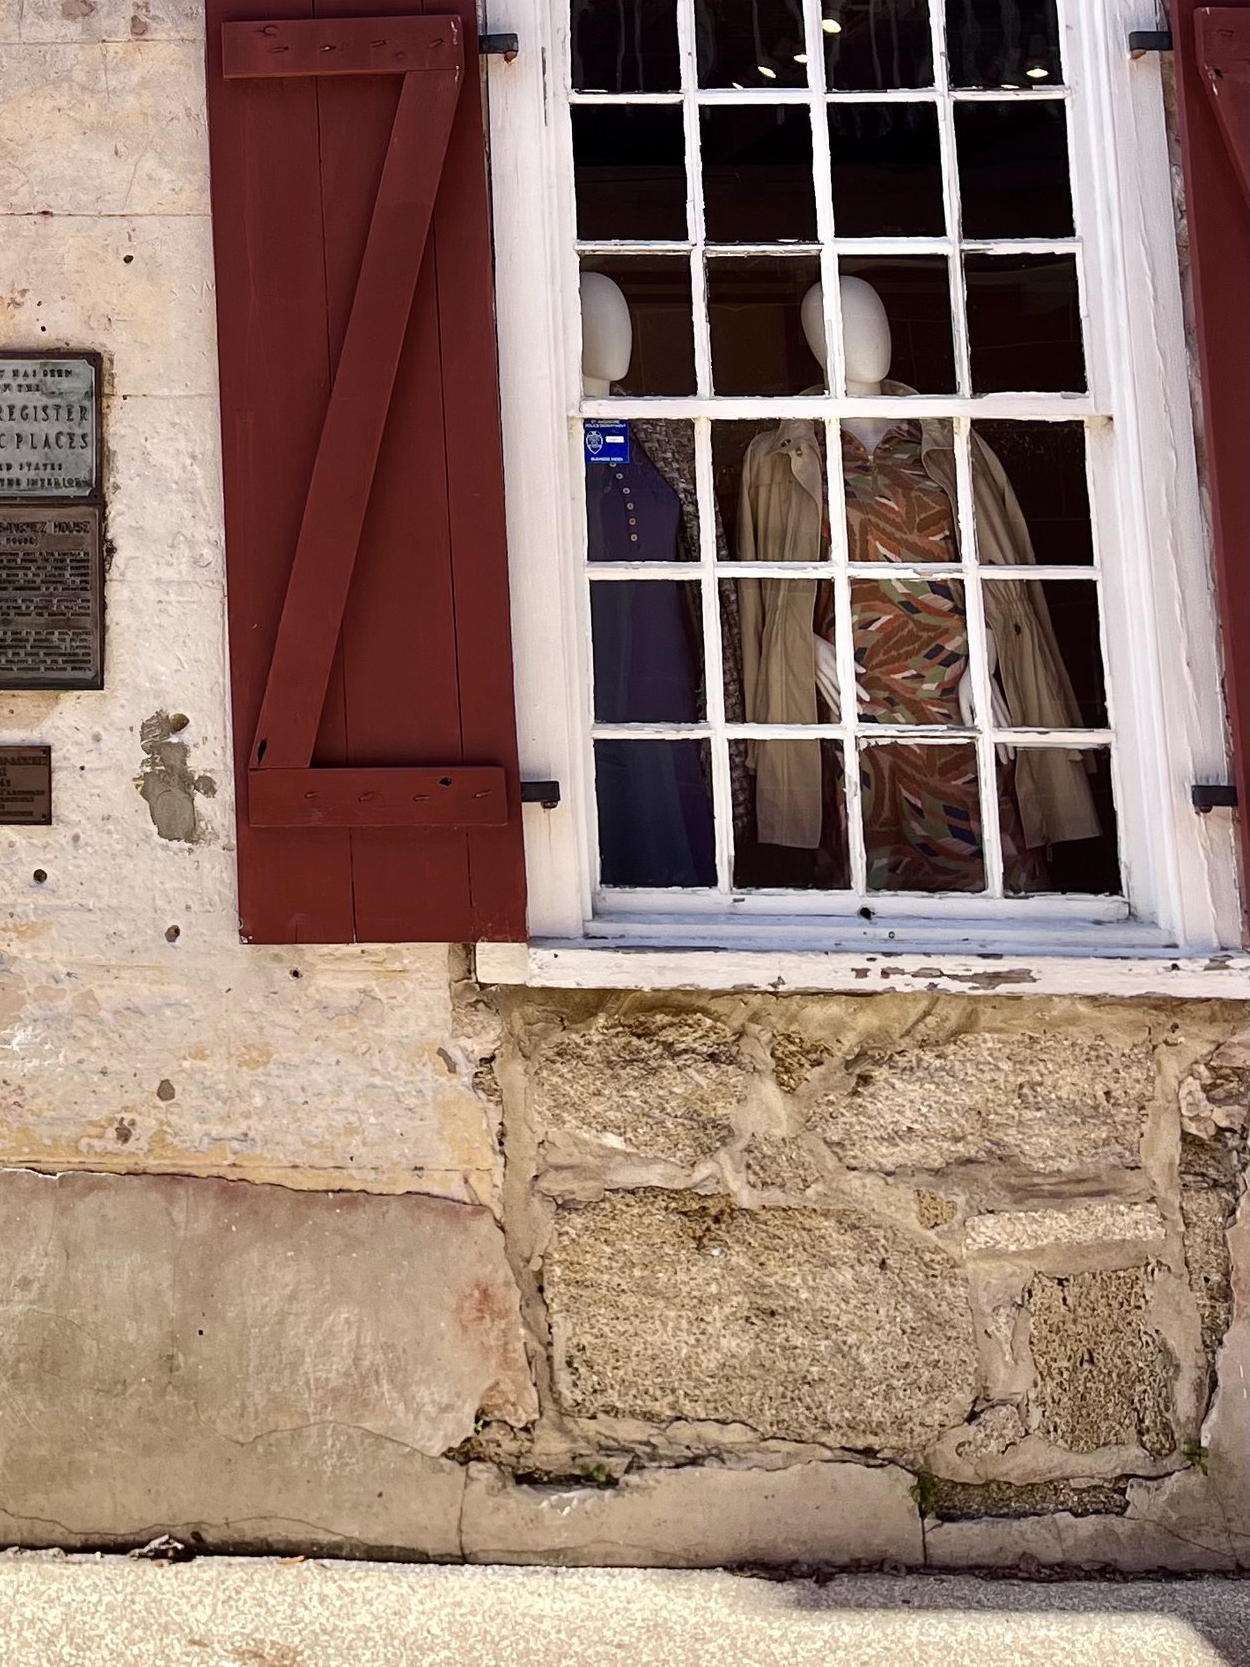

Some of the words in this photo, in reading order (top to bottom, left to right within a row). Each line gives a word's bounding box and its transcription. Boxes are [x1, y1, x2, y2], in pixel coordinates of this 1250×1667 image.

[12, 369, 37, 378] HAS
[42, 369, 73, 378] BEEN
[17, 384, 41, 392] THE
[15, 432, 89, 450] PLACES
[19, 462, 63, 471] STATES
[0, 477, 21, 487] THE
